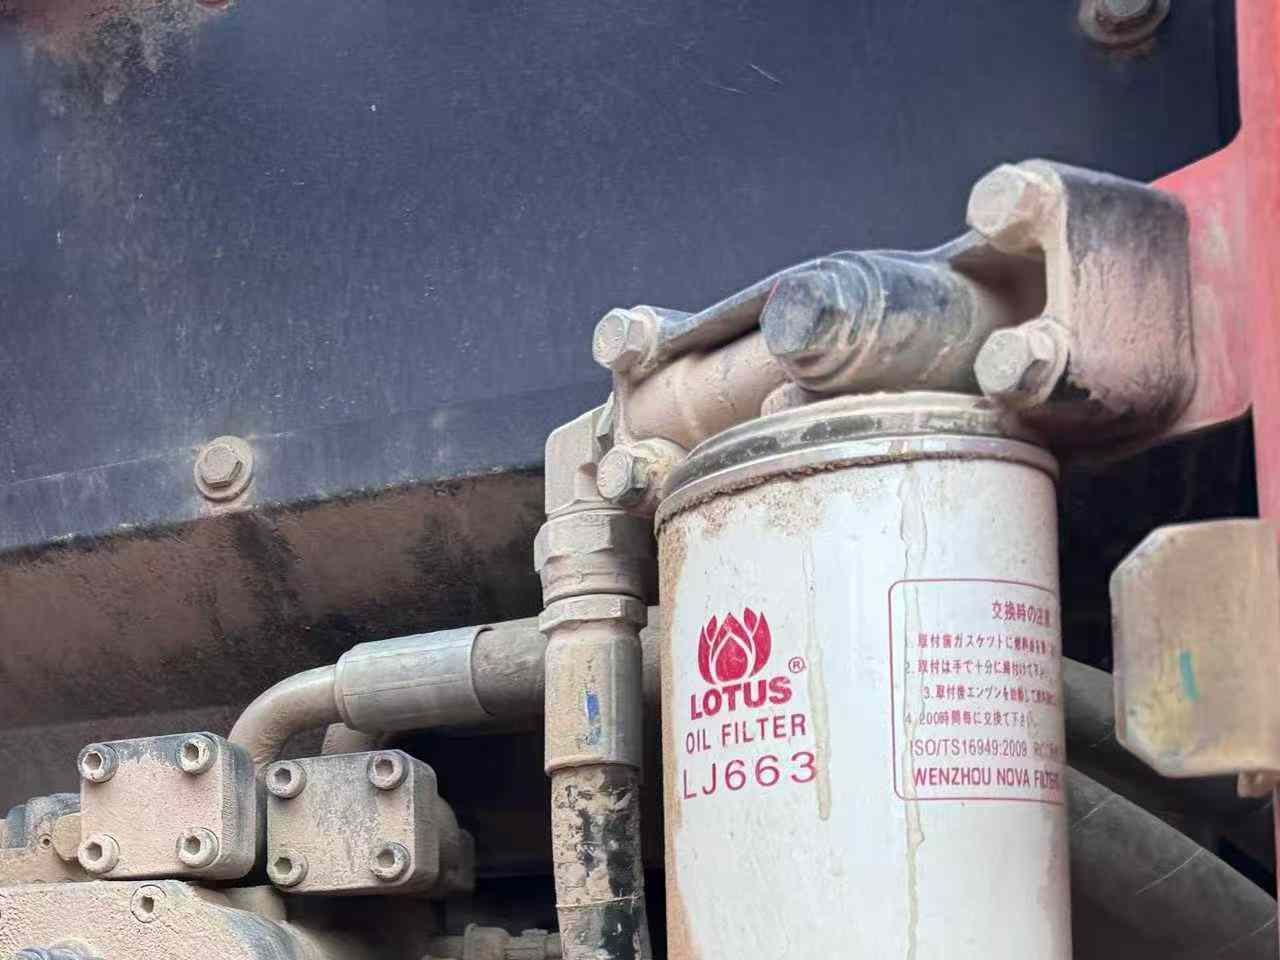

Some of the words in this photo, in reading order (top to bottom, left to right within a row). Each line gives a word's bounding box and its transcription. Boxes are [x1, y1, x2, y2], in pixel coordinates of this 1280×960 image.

[690, 676, 792, 720] LOTUS
[686, 728, 711, 754] OIL
[722, 713, 806, 747] FILTER
[683, 751, 817, 799] LJ663
[913, 767, 991, 786] WENZHOU
[996, 767, 1031, 788] NOVA
